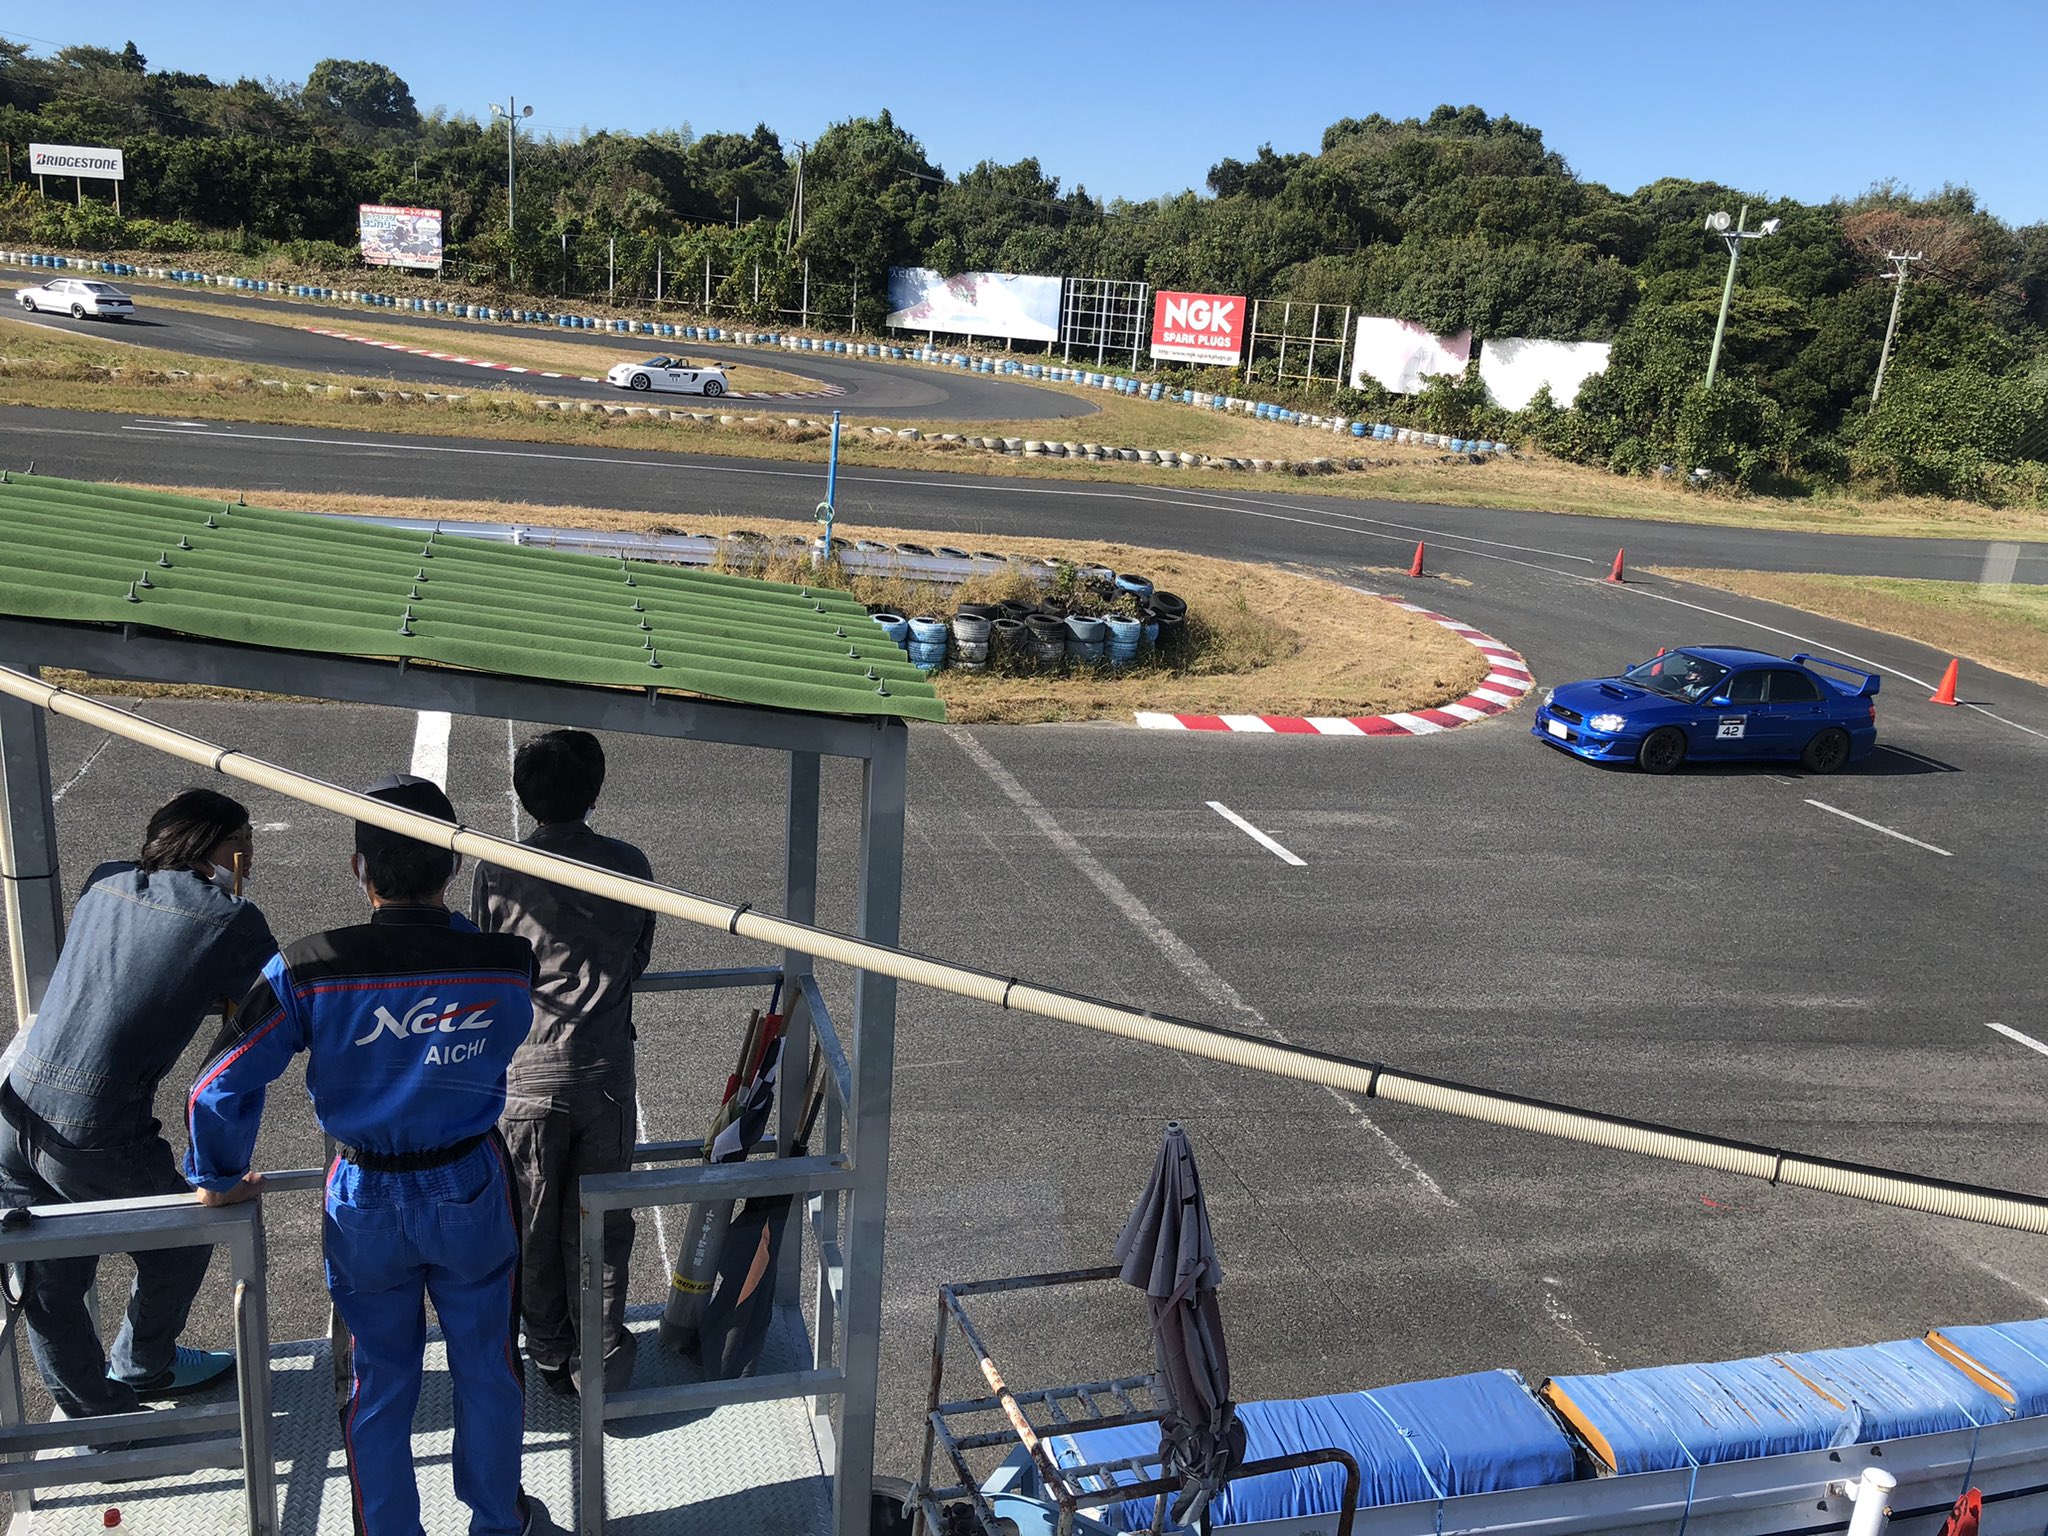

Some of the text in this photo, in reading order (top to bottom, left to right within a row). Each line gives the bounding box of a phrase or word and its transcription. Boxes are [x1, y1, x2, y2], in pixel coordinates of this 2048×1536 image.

[36, 153, 118, 170] BRIDGESTONE
[1164, 298, 1234, 334] NGK
[1163, 332, 1231, 348] SPARK PLUGS
[1722, 726, 1740, 736] 42
[354, 997, 496, 1046] Netz
[424, 1038, 487, 1065] AICHI
